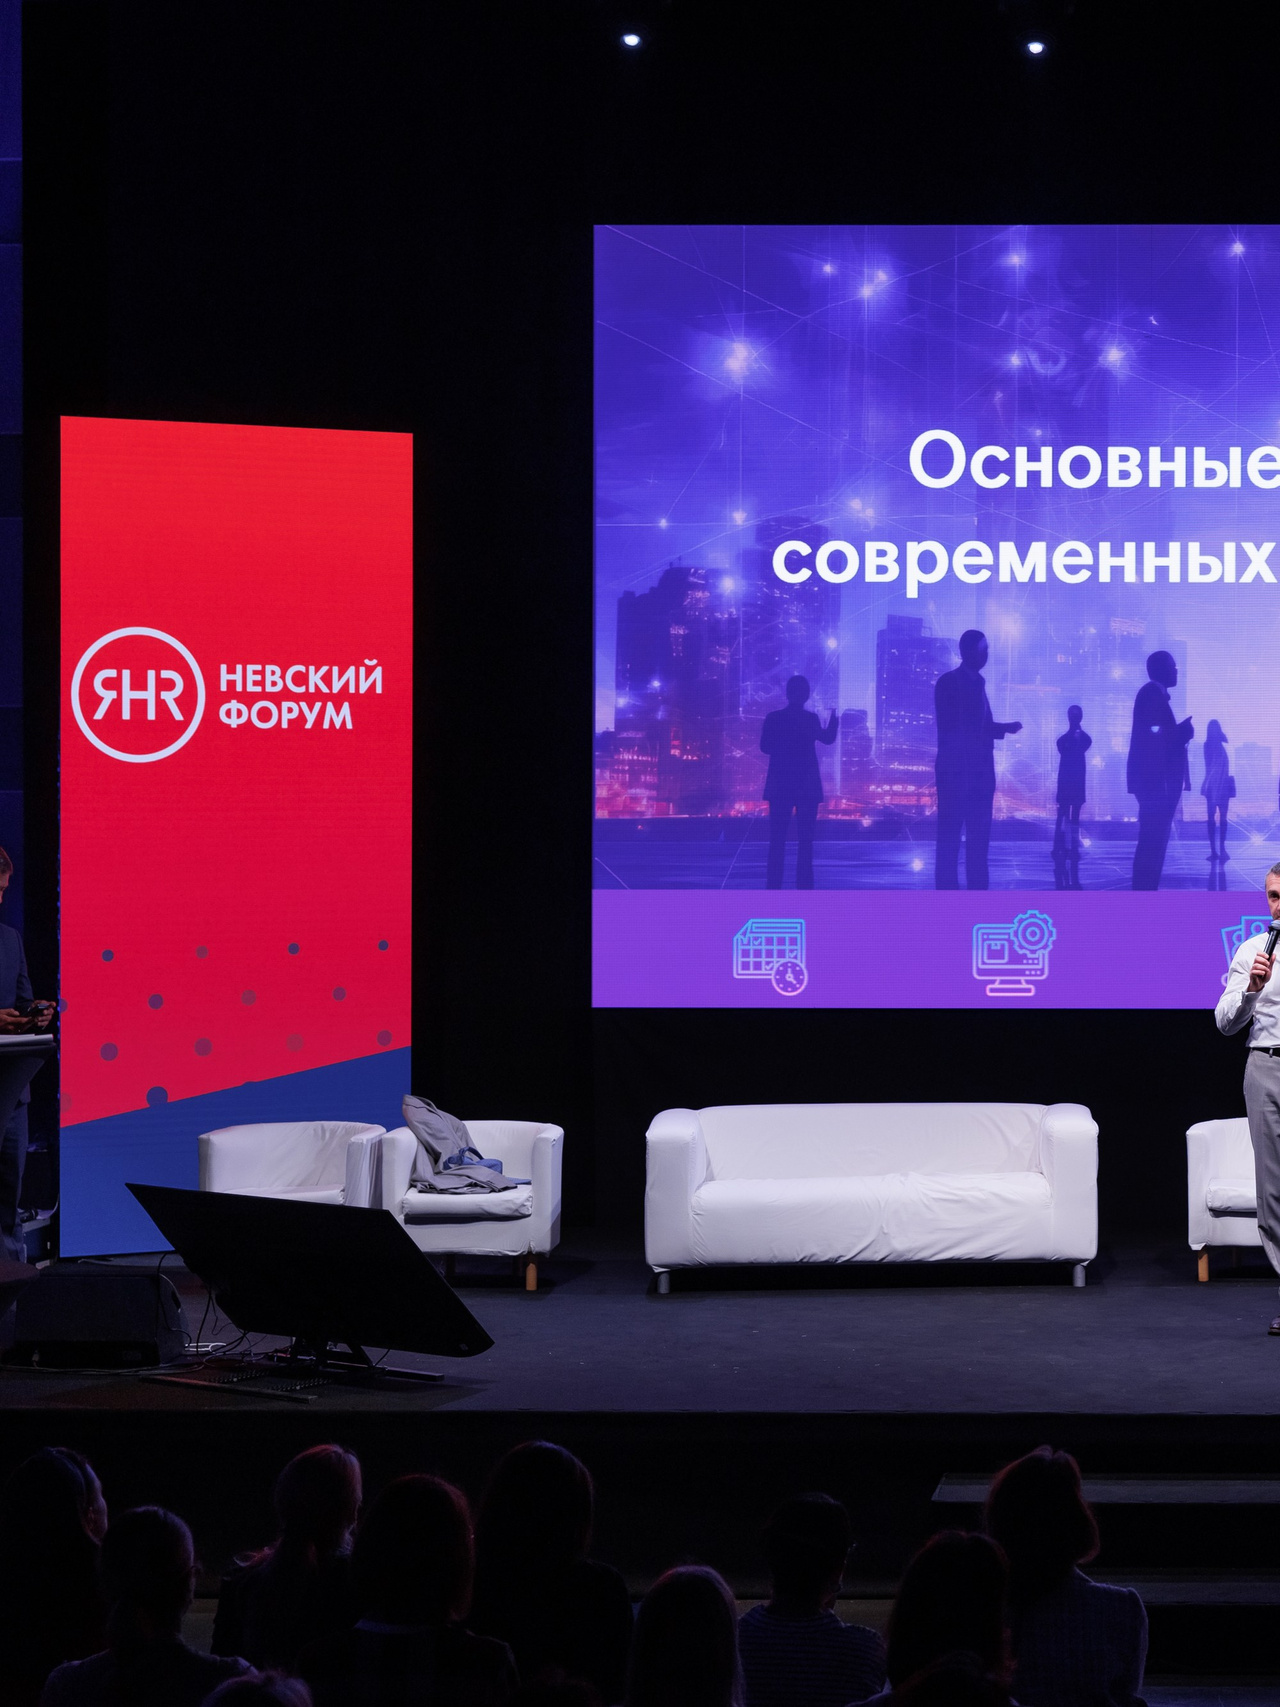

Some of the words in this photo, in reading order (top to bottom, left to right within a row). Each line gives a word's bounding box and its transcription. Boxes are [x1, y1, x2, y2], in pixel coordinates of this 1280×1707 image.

[771, 540, 1278, 599] современных
[219, 658, 383, 694] НЕВСКИЙ
[218, 699, 354, 730] ФОРУМ
